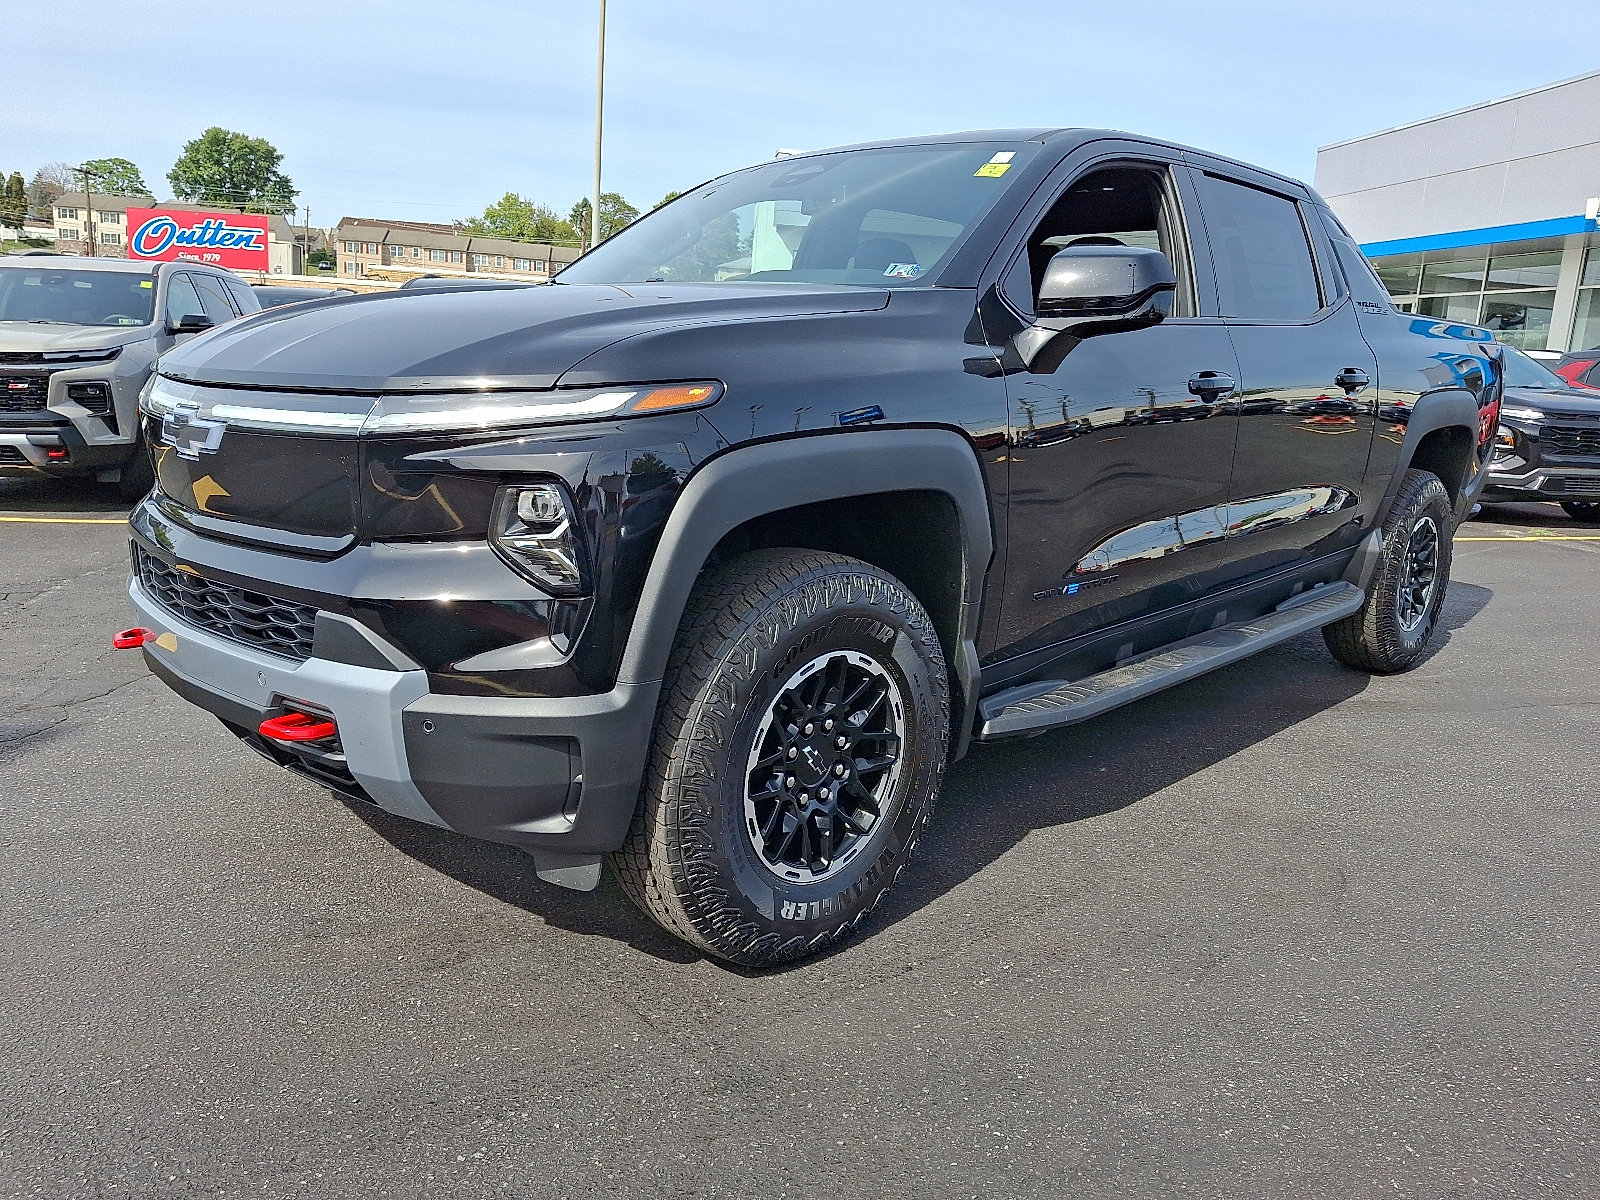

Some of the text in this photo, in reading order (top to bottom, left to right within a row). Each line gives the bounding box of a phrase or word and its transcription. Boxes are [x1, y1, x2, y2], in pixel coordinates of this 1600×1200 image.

[132, 215, 265, 257] Outten
[178, 252, 221, 262] Since 1979
[780, 846, 897, 921] WRANGLER
